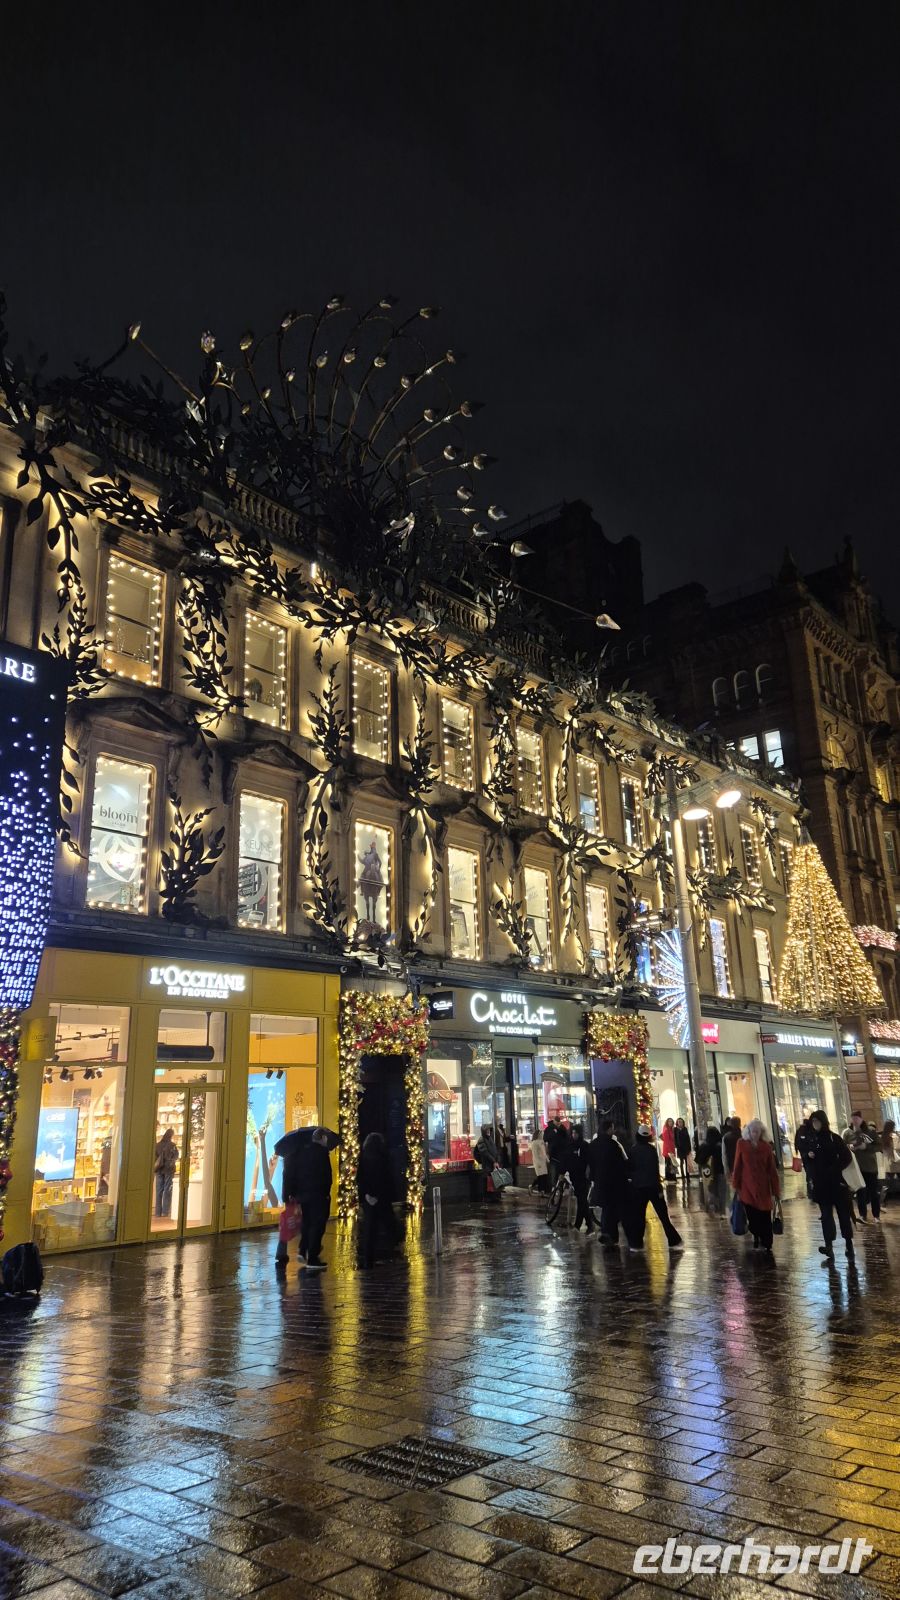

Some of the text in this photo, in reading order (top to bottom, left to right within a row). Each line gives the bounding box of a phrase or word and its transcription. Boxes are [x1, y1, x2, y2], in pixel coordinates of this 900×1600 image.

[0, 657, 36, 683] RE
[150, 966, 245, 991] L'OCCITANE
[501, 993, 527, 1004] HOTEL
